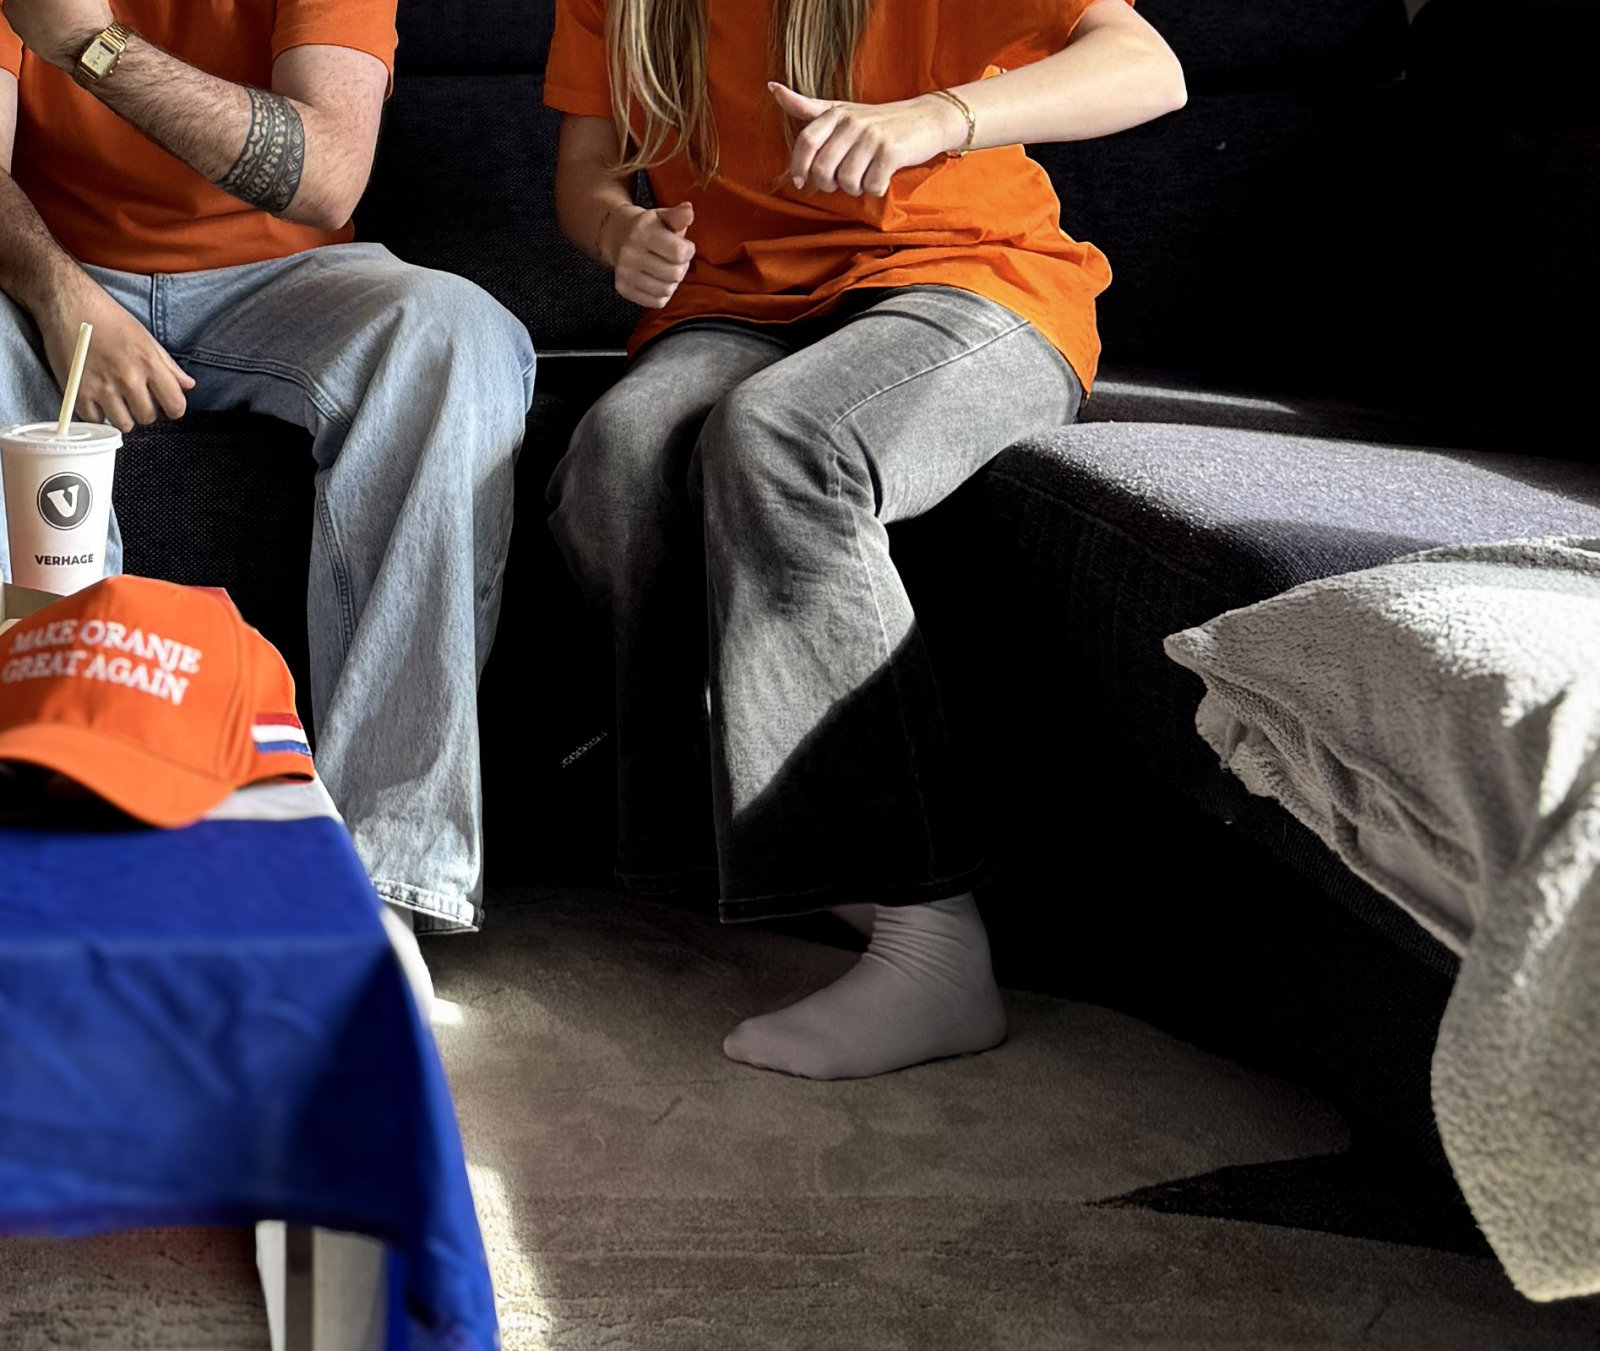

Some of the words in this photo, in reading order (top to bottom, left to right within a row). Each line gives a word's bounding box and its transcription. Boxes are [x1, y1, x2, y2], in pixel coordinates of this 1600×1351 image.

[47, 484, 80, 518] V
[35, 553, 94, 566] VERHAGE
[9, 619, 79, 654] MAKE
[79, 620, 203, 675] ORANJE
[2, 650, 88, 684] GREAT
[85, 654, 190, 705] AGAIN
